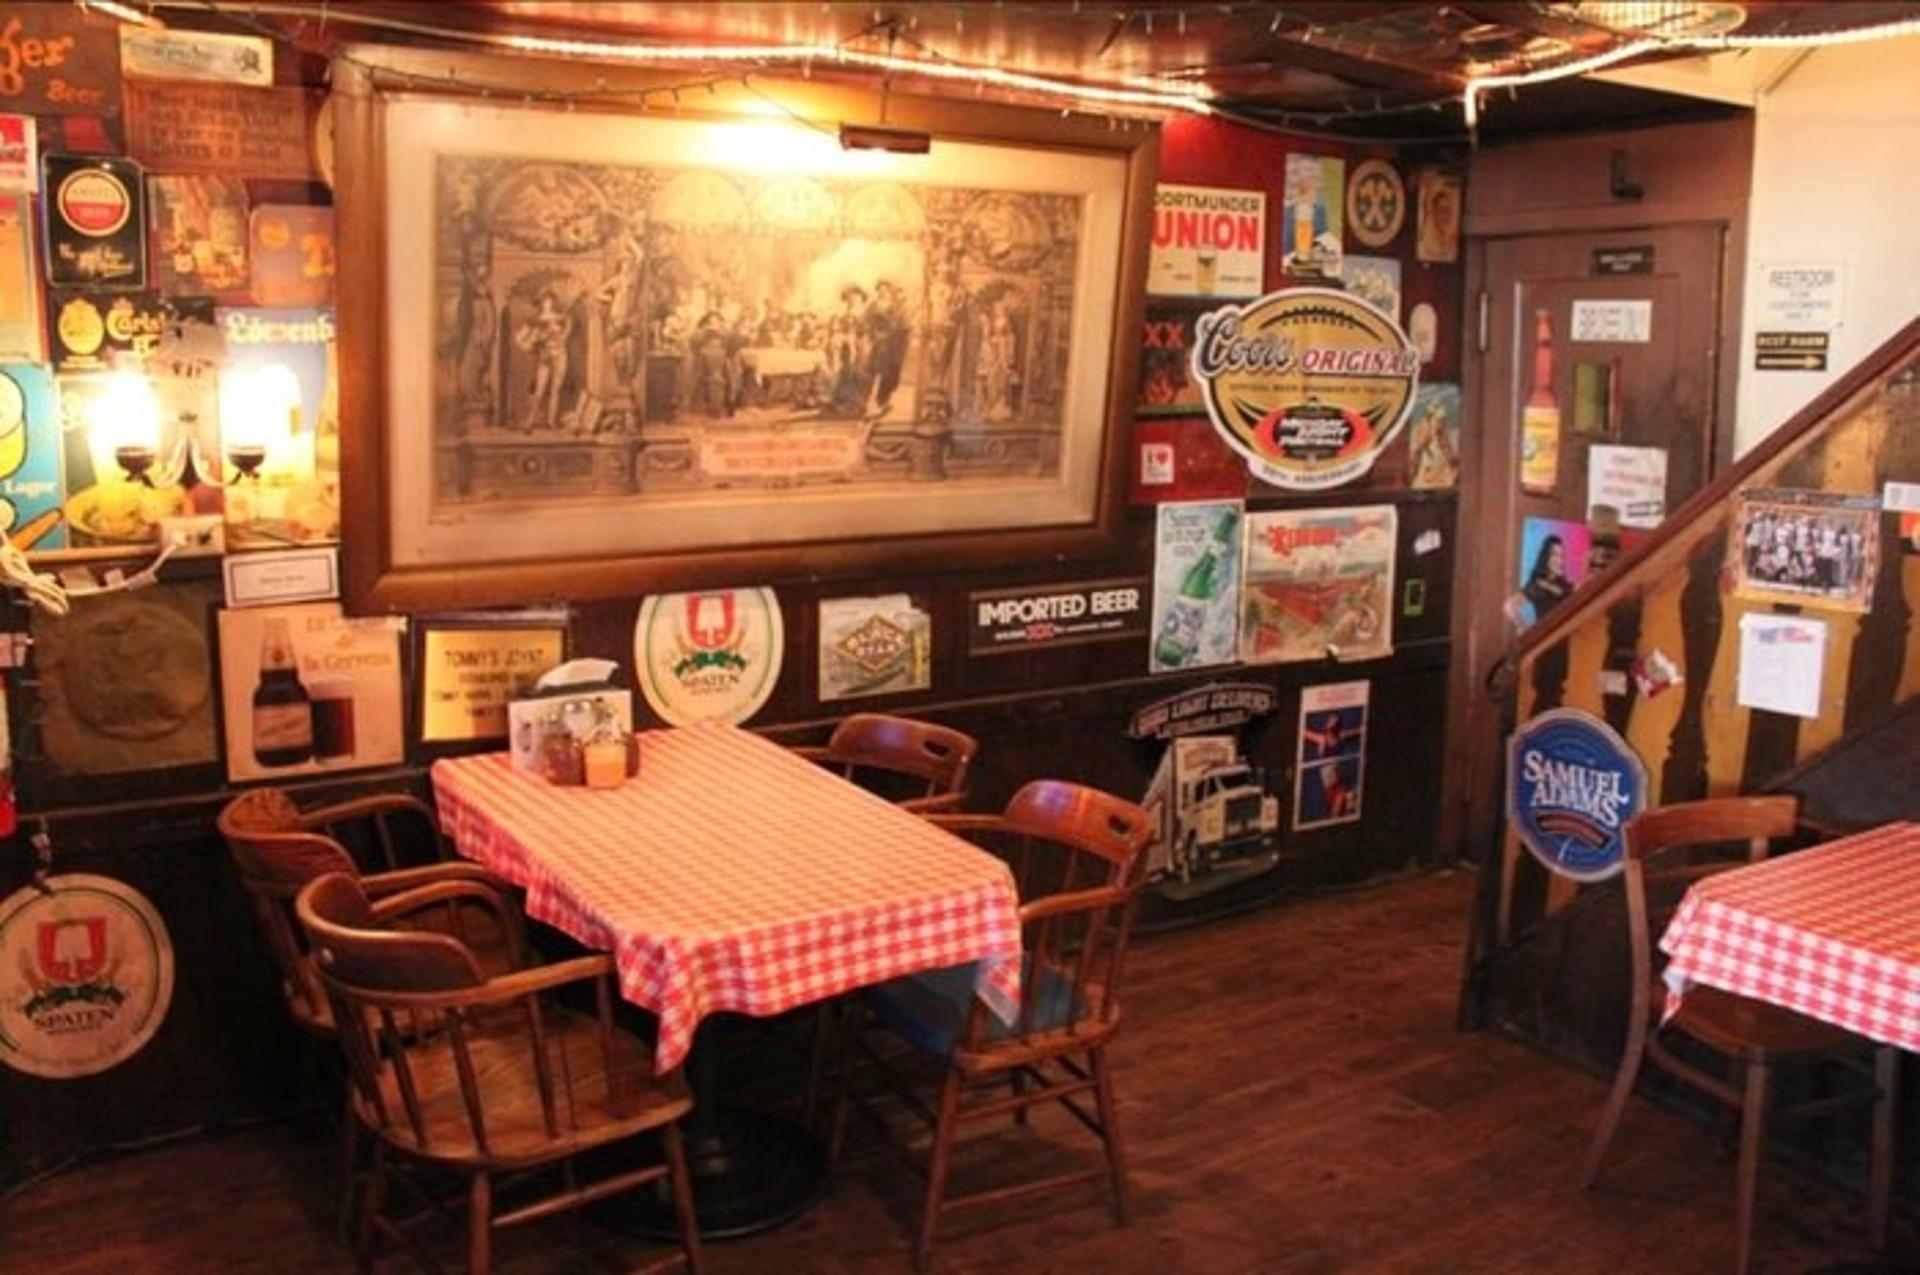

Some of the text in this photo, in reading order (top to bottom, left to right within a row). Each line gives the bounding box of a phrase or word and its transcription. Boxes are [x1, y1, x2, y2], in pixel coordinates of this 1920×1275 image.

[1152, 210, 1258, 252] UNION
[1302, 350, 1416, 375] ORIGINAL
[978, 588, 1139, 627] IMPORTED BEER
[1524, 750, 1629, 805] SAMUEL
[1530, 782, 1618, 827] ADAMS
